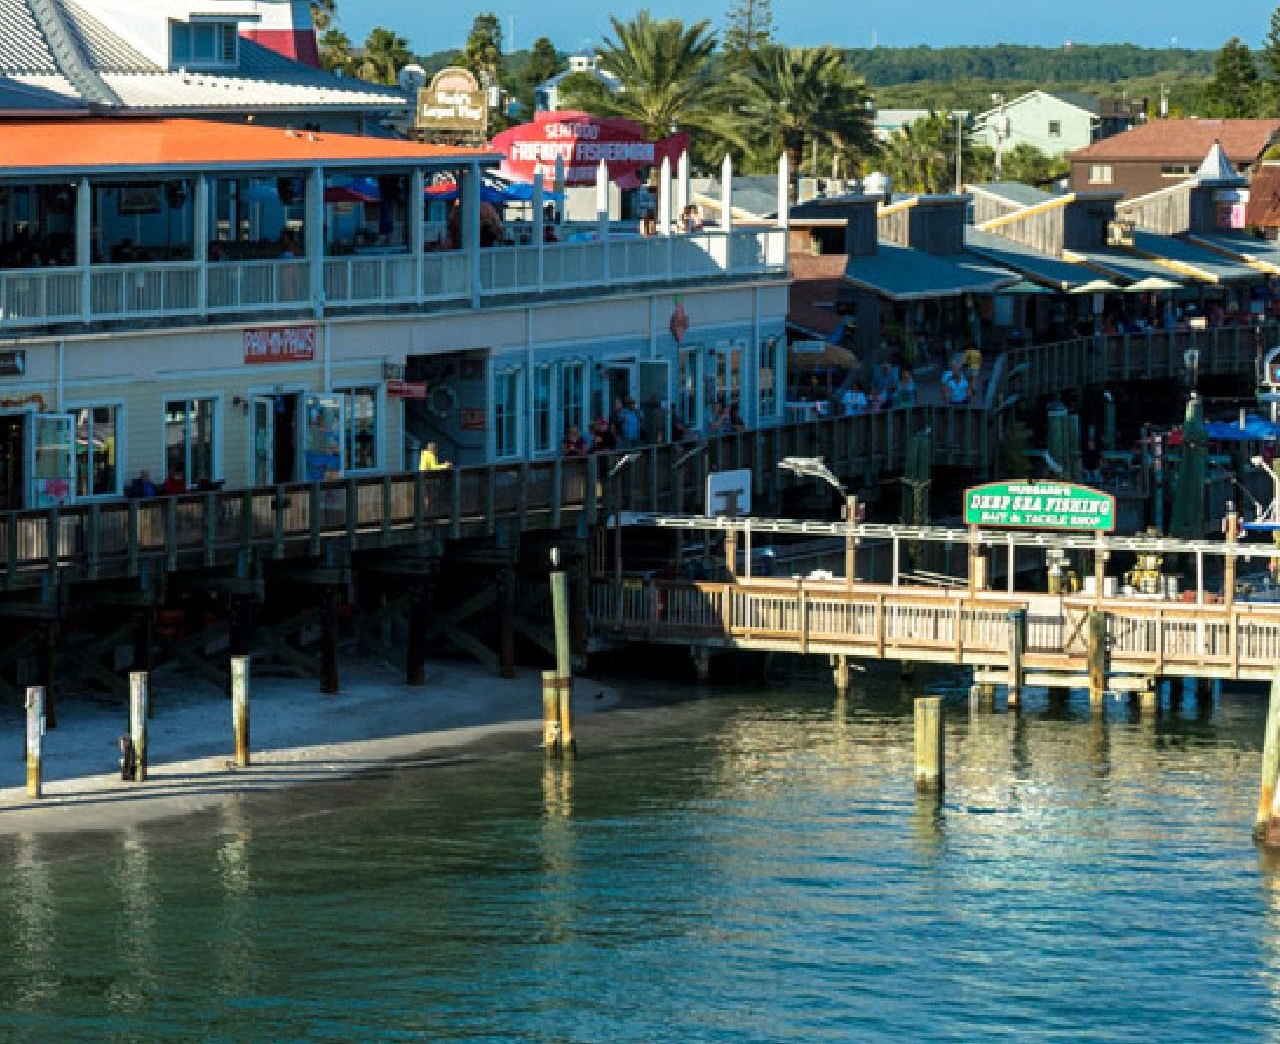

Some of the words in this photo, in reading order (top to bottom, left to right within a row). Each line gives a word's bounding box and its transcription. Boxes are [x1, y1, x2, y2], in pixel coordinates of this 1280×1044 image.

[970, 494, 1011, 510] DEEP
[1012, 496, 1042, 511] SEA
[1044, 497, 1110, 516] FISHING
